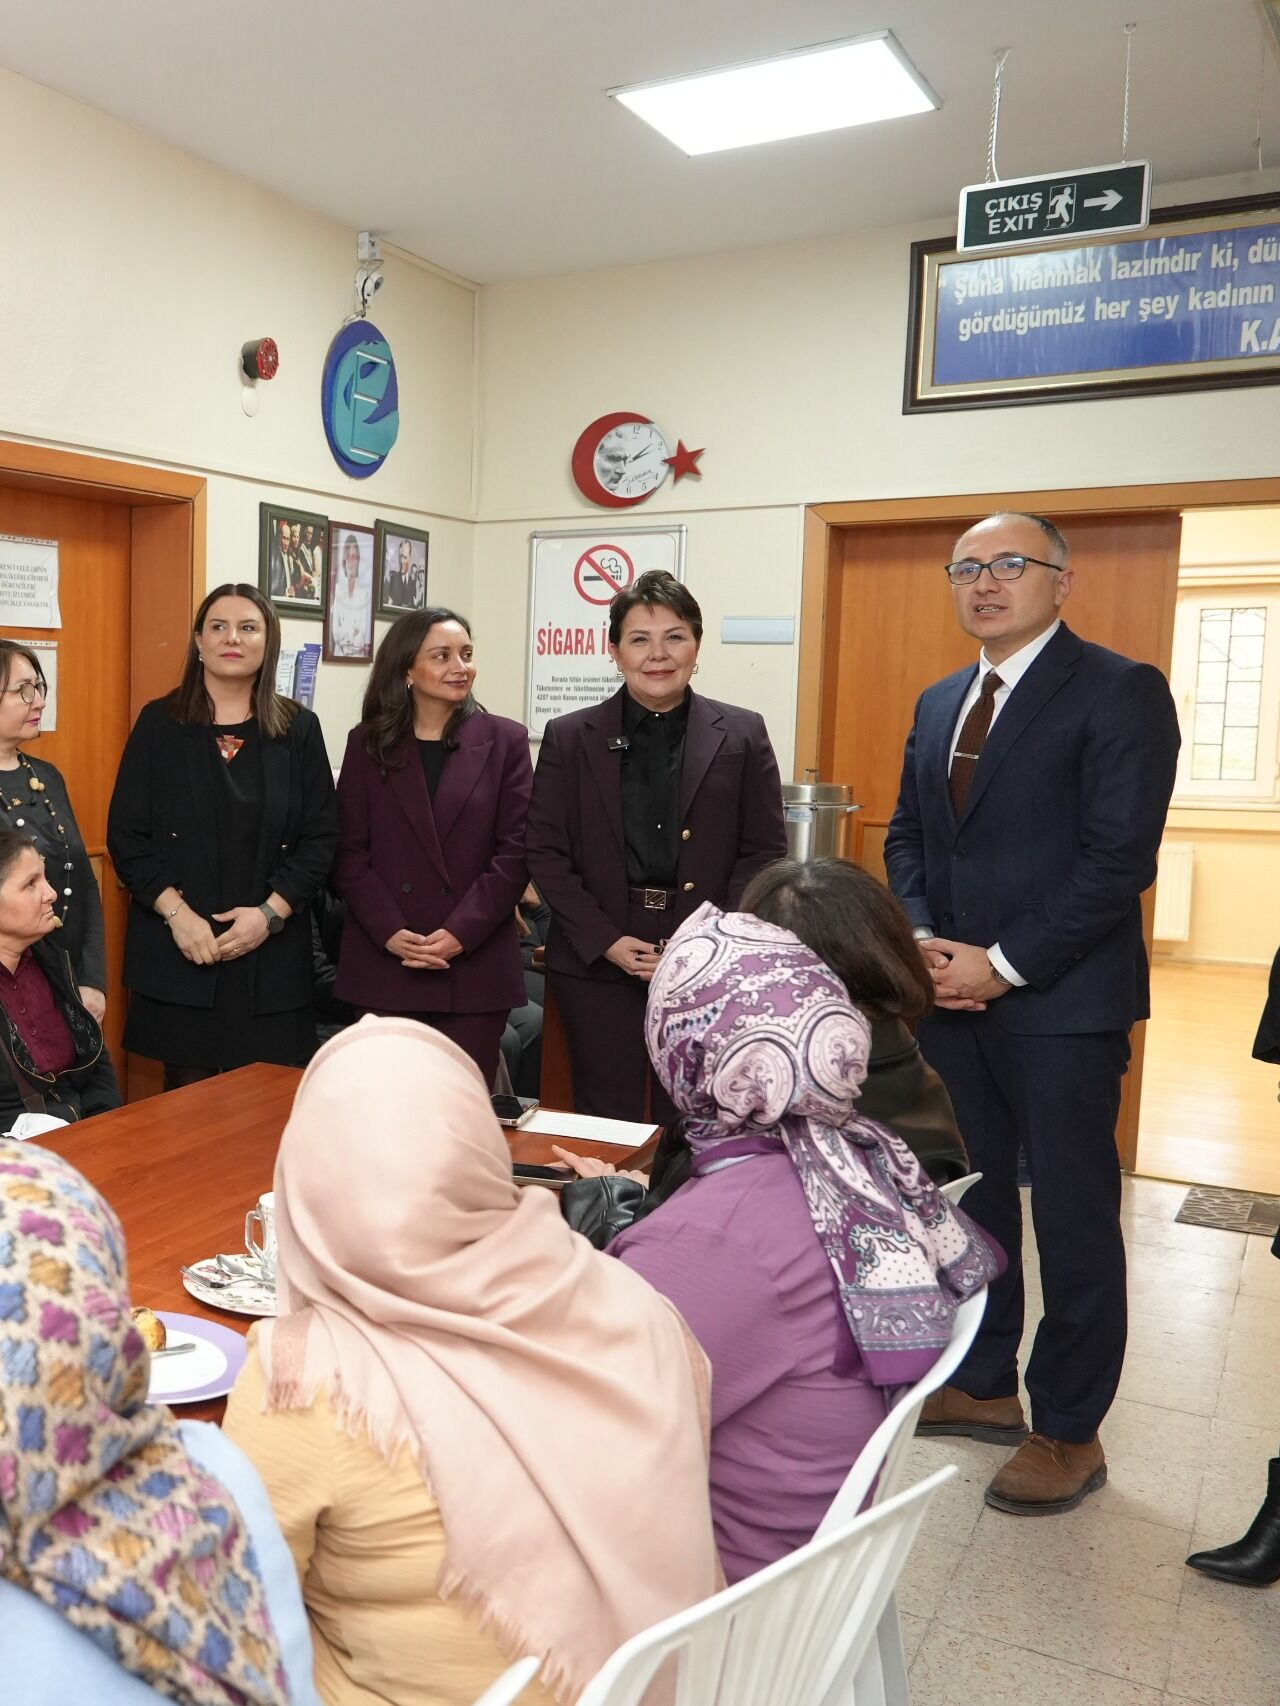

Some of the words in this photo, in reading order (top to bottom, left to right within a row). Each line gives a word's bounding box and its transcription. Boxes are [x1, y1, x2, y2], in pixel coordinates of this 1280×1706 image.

[984, 192, 1043, 218] ÇIKIŞ
[988, 213, 1038, 235] EXIT
[954, 271, 1004, 305] Şuna
[1111, 248, 1202, 280] lazımdır
[1210, 242, 1239, 272] ki,
[1248, 237, 1280, 264] dü
[959, 301, 1085, 341] gördüğümüz
[1094, 297, 1131, 321] her
[1138, 294, 1180, 322] şey
[1188, 283, 1274, 311] kadının
[536, 622, 596, 656] SİGARA
